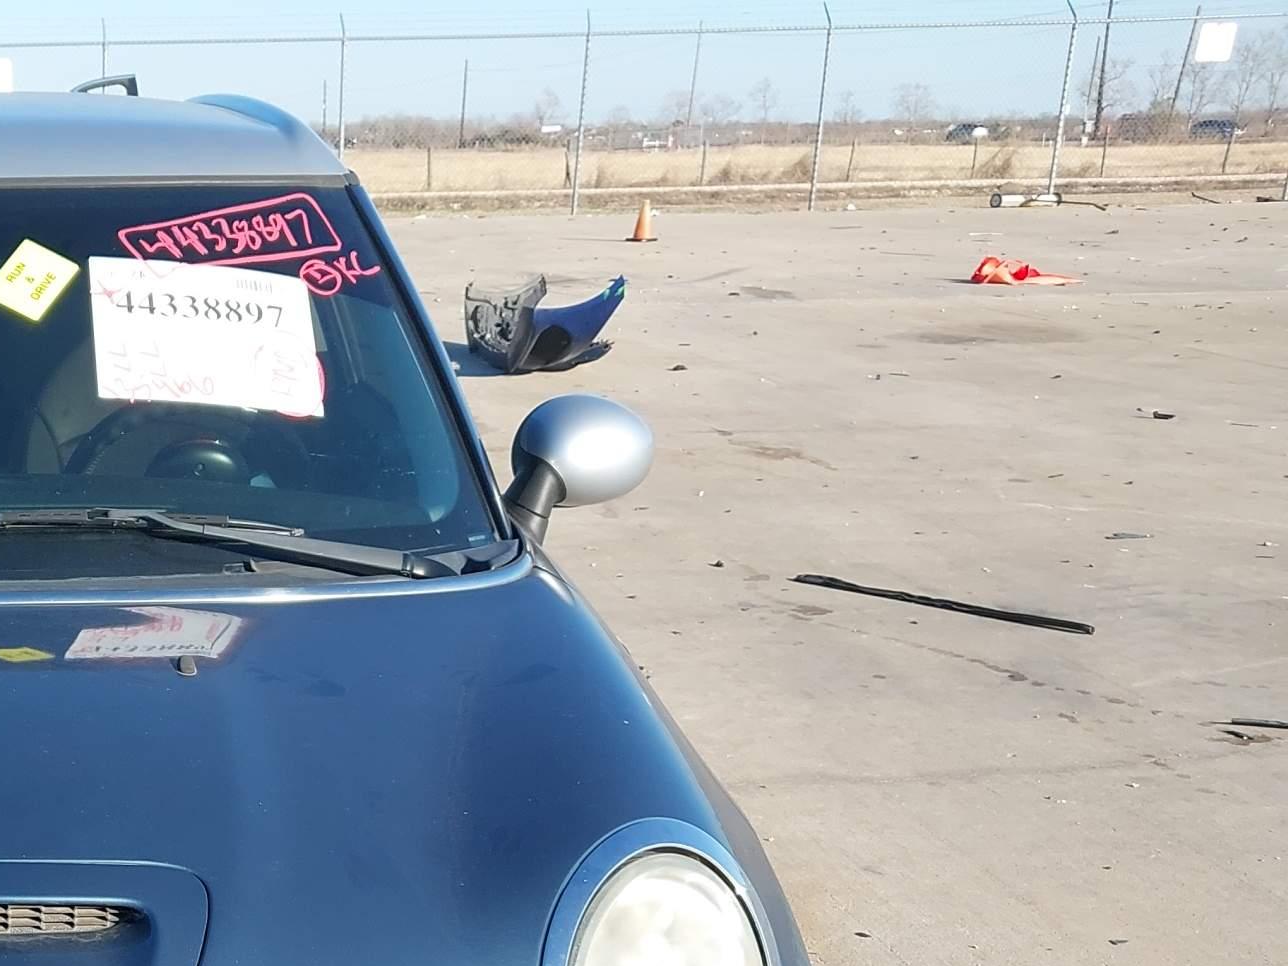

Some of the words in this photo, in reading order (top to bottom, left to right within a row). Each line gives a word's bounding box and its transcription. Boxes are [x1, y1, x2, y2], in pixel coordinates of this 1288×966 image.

[6, 262, 25, 283] RUN
[30, 272, 56, 301] DRIVE
[116, 290, 283, 328] 44338897
